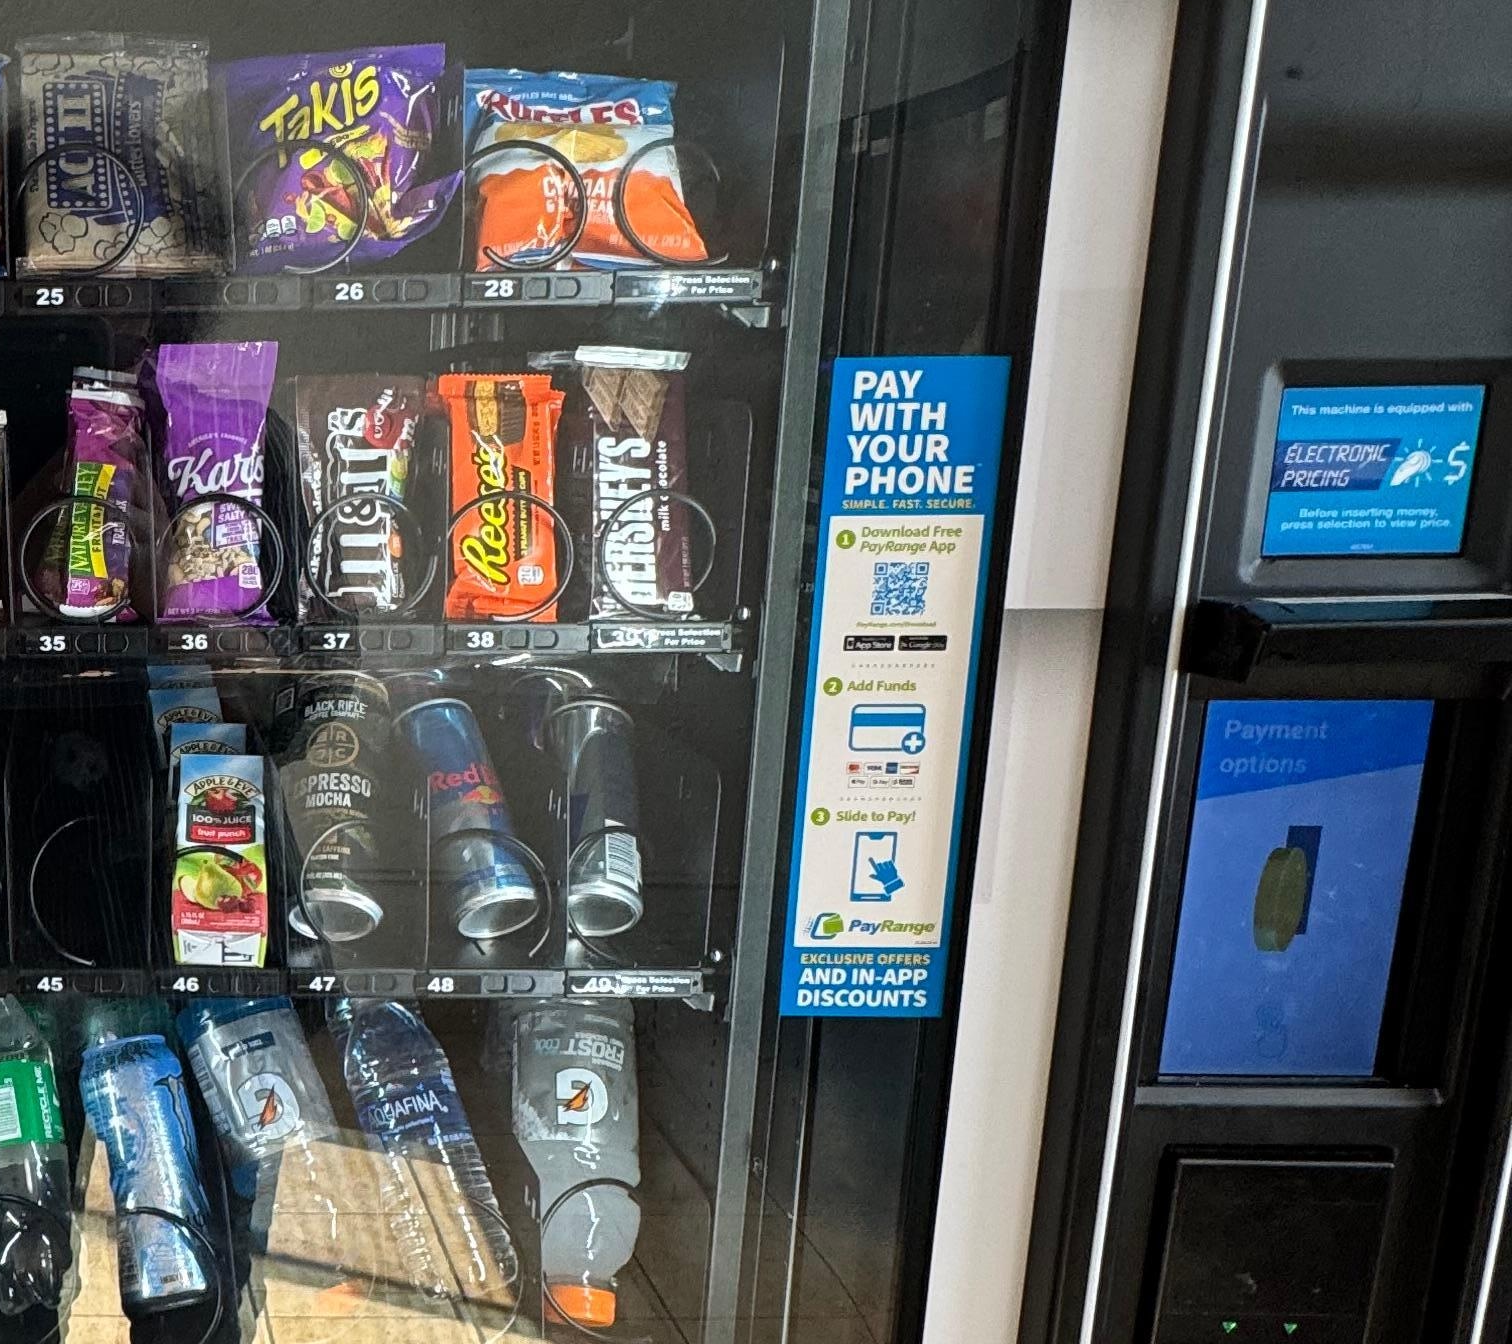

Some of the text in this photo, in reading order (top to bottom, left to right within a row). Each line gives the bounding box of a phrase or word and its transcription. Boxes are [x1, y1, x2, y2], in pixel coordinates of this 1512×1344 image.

[36, 288, 64, 306] 25
[335, 282, 364, 301] 26
[484, 279, 514, 298] 28
[853, 370, 924, 399] PAY
[850, 402, 947, 431] WITH
[1291, 401, 1473, 416] This machine is equipped with
[847, 434, 950, 463] YOUR
[1283, 442, 1391, 464] ELECTRONIC
[655, 440, 671, 532] milk cocolate
[844, 465, 976, 495] PHONE
[1280, 469, 1350, 488] PRICING
[1299, 507, 1393, 518] Before inserting
[861, 526, 962, 538] Download Free
[1281, 518, 1417, 532] press selection to view
[860, 541, 956, 554] PayRange App
[39, 636, 66, 652] 35
[181, 634, 208, 650] 36
[323, 633, 350, 649] 37
[467, 632, 495, 648] 38
[846, 680, 917, 692] Add Funds
[304, 699, 335, 717] BLACK
[1224, 719, 1329, 741] Payment
[1219, 755, 1307, 778] options
[193, 778, 226, 794] APPLE
[236, 780, 256, 796] EVE
[305, 792, 352, 808] MOCHA
[223, 814, 252, 824] JUICE
[836, 810, 916, 825] Slide to Pay!
[848, 918, 936, 936] PayRange
[800, 953, 931, 966] EXCLUSIVE OFFERS
[37, 976, 64, 991] 45
[172, 976, 200, 992] 46
[309, 976, 336, 992] 47
[427, 977, 454, 993] 48
[799, 968, 928, 986] AND IN-APP
[797, 989, 928, 1008] DISCOUNTS
[560, 1039, 624, 1065] FROST
[555, 1067, 609, 1126] G
[36, 1086, 54, 1139] RECYCLE
[369, 1089, 443, 1129] AQUAFINA
